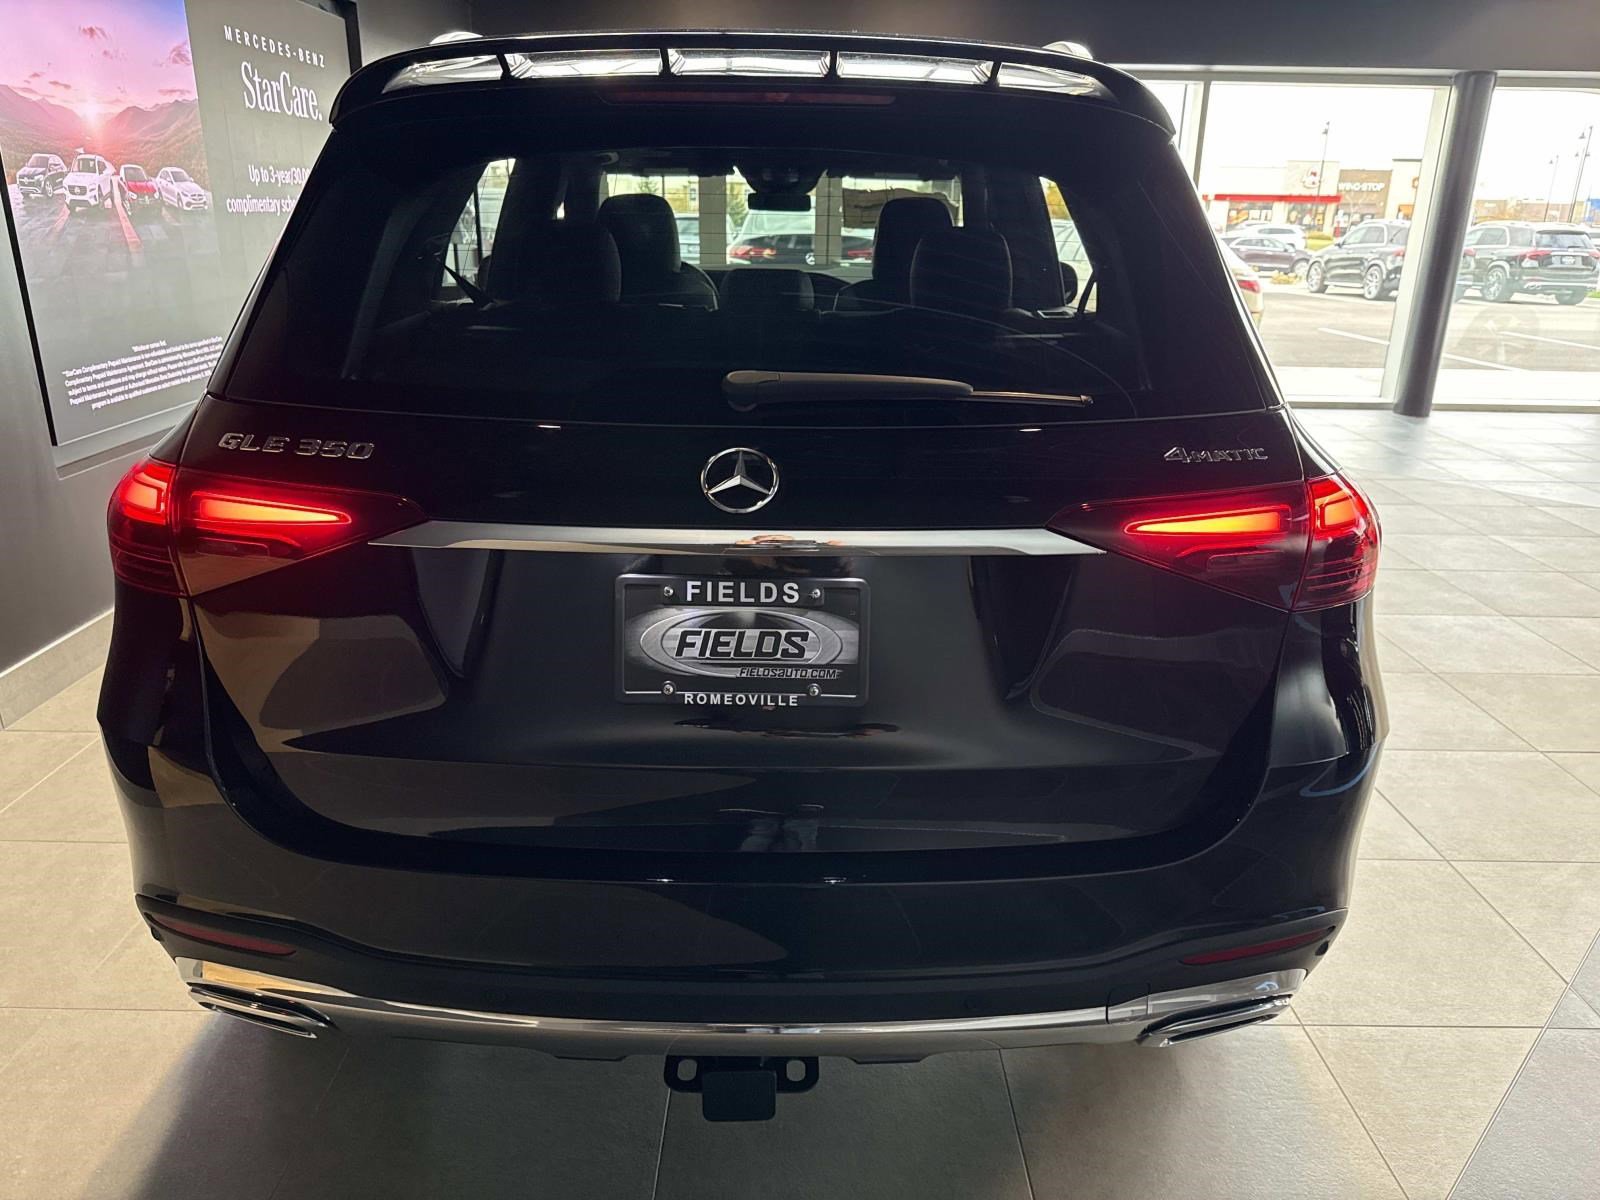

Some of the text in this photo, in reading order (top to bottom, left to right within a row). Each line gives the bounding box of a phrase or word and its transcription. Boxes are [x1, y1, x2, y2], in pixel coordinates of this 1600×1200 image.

[223, 24, 325, 69] MERCEDES-BENZ
[241, 60, 323, 121] StarCare.
[248, 164, 261, 187] Up
[260, 166, 269, 183] to
[226, 194, 281, 217] complimentary
[218, 432, 375, 460] GLE 350
[1163, 446, 1269, 463] 4MATIC
[686, 580, 800, 604] FIELDS
[674, 629, 810, 659] FIELDS
[684, 693, 799, 707] ROMEOVILLE
